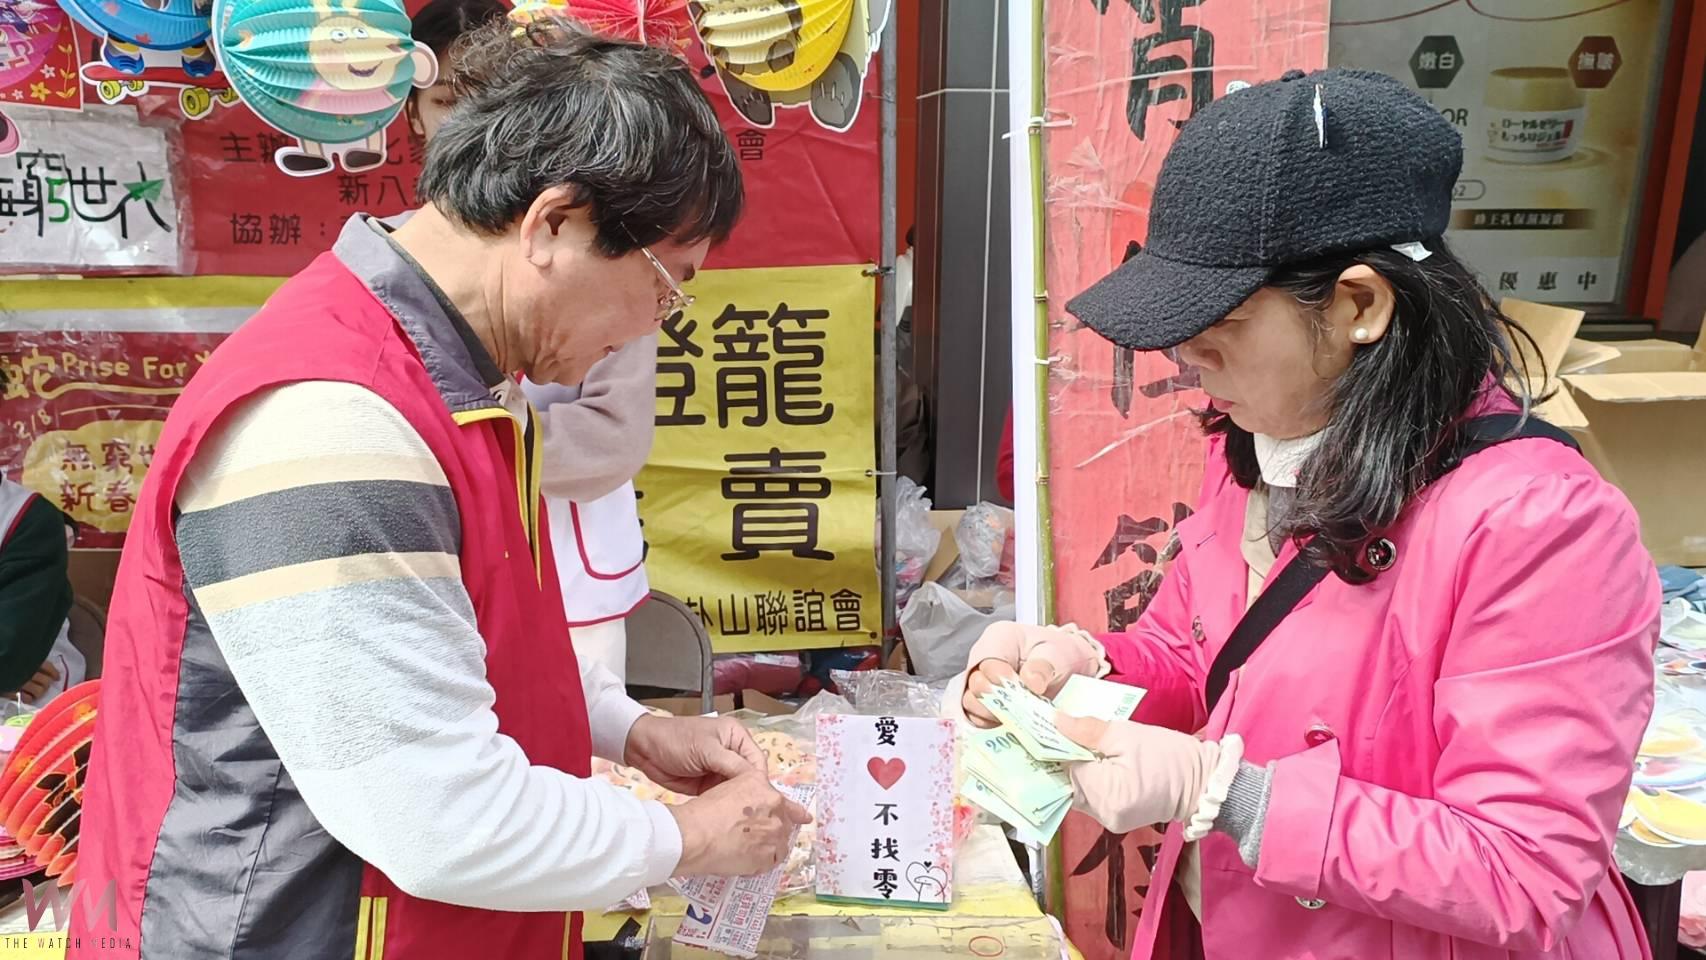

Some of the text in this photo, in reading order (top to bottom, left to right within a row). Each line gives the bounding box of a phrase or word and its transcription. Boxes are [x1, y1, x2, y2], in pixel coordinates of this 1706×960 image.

[736, 129, 766, 160] 會
[337, 173, 420, 207] 新八
[1499, 271, 1597, 290] 優惠中
[62, 352, 130, 377] Prise
[142, 356, 187, 380] For
[60, 481, 136, 513] 新春
